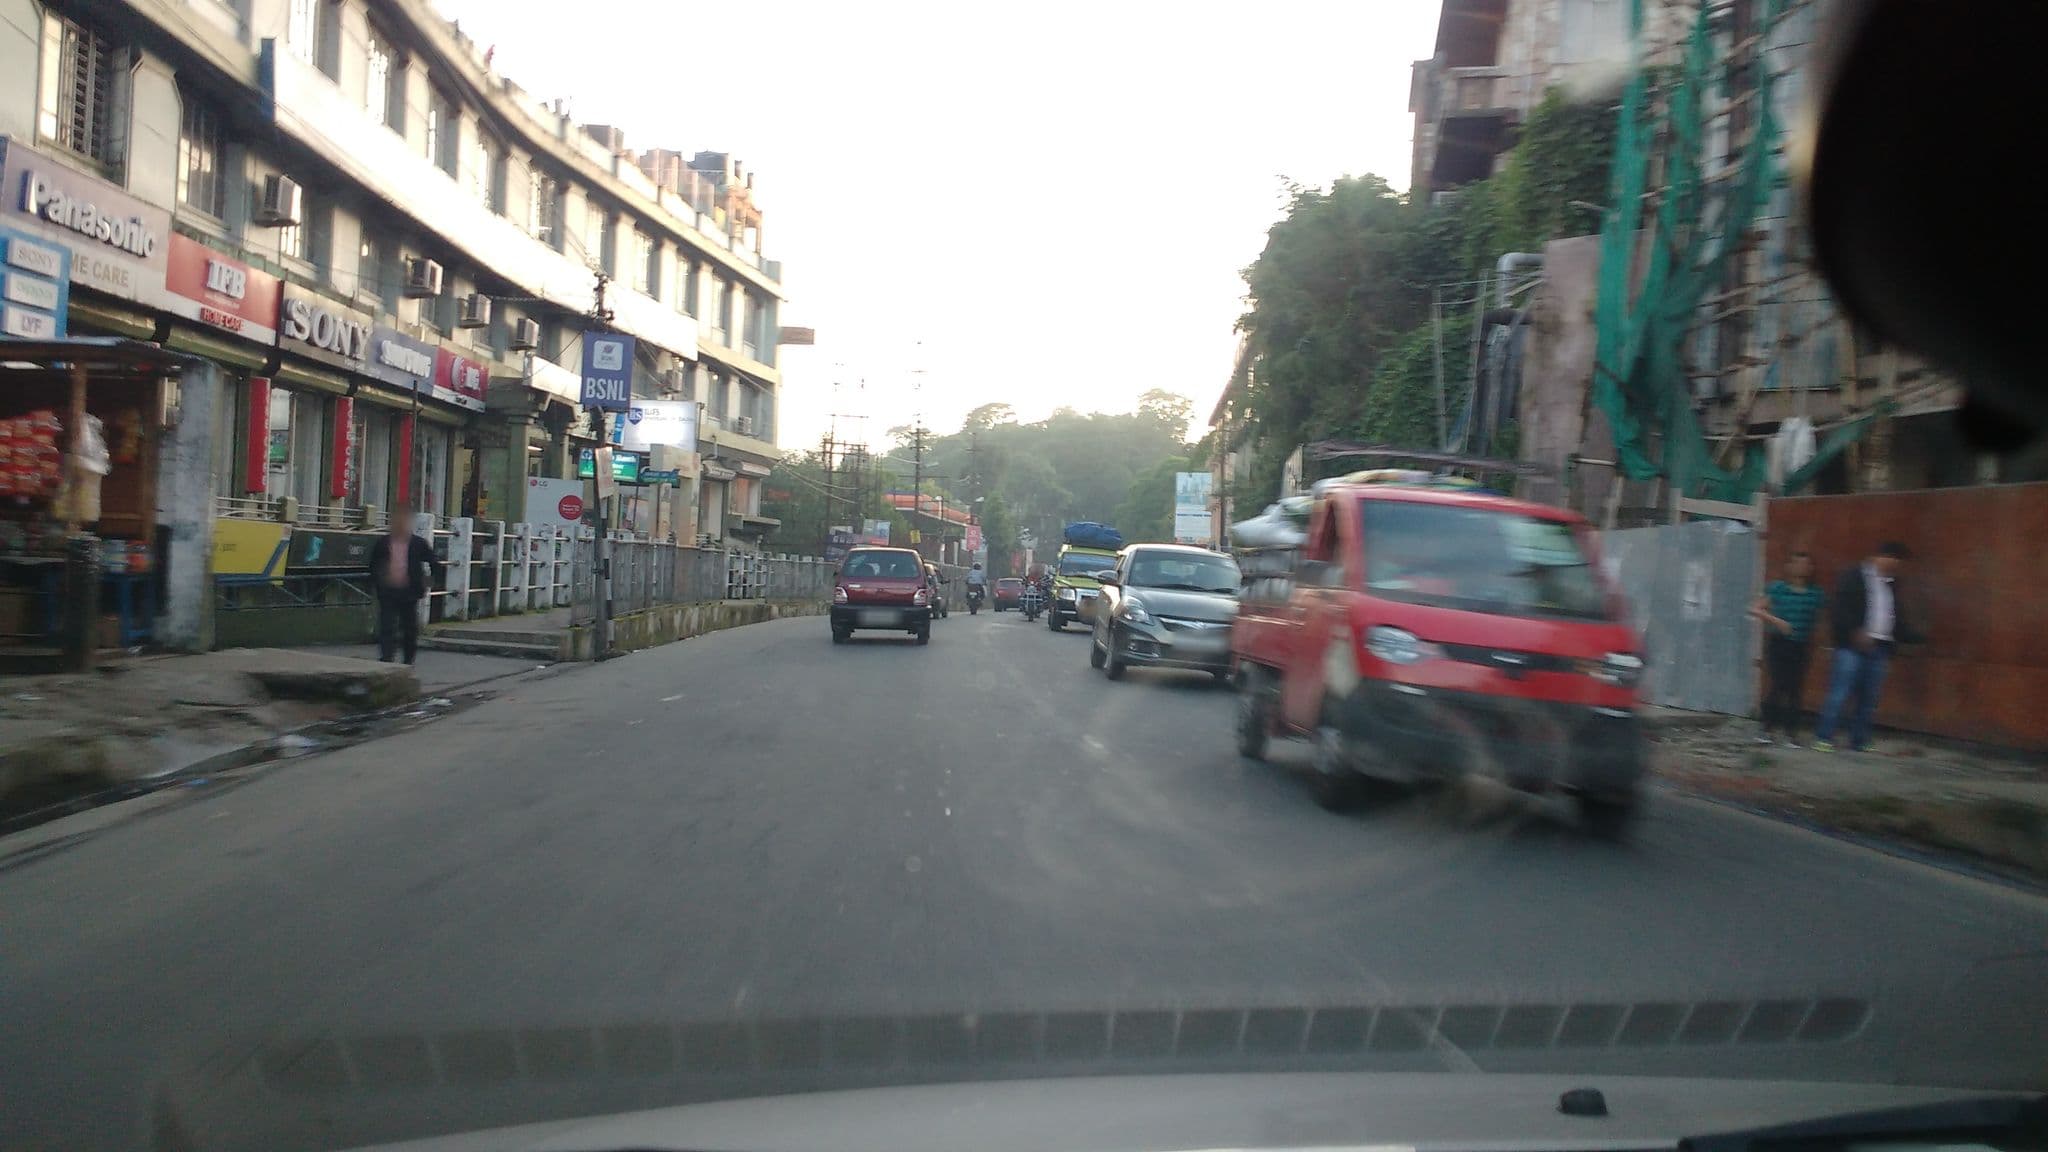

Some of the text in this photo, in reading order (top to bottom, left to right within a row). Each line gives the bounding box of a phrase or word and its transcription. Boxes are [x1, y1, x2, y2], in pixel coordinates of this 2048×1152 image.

[25, 170, 154, 257] Panasonic
[93, 260, 129, 288] CARE
[207, 259, 246, 299] IFB
[286, 298, 370, 361] SONY
[585, 377, 627, 402] BSNL
